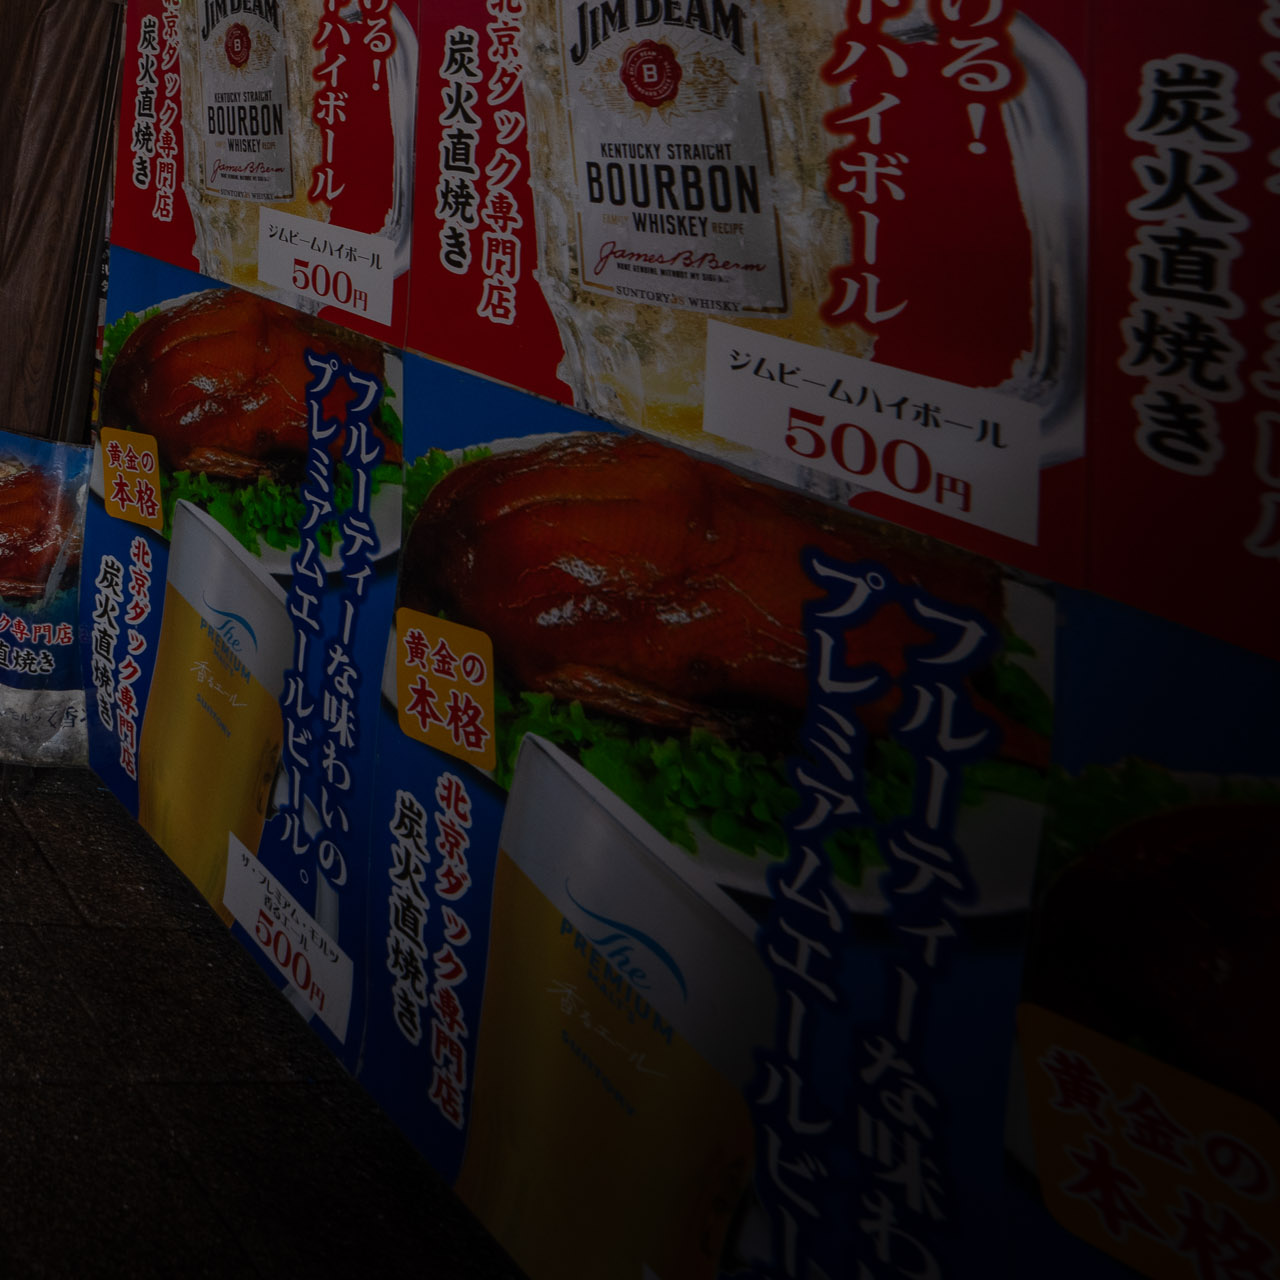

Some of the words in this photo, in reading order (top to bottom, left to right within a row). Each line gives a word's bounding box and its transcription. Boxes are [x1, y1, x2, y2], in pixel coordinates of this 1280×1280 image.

[131, 14, 160, 190] 炭火直焼き
[214, 91, 241, 103] KENTUCKY
[243, 89, 273, 102] STRAIGHT
[641, 63, 659, 83] B
[207, 103, 284, 136] BOURBON
[228, 138, 261, 153] WHISKEY
[439, 26, 482, 275] 炭火直焼き
[600, 142, 661, 160] KENTUCKY
[667, 142, 732, 161] STRAIGHT
[586, 161, 761, 214] BOURBON
[267, 221, 383, 272] ジムビームハイボール
[632, 212, 708, 237] WHISKEY
[711, 222, 745, 235] RECIPE
[290, 255, 369, 313] 500円
[1120, 55, 1250, 477] 炭火直焼き
[688, 297, 741, 312] WHISKY
[728, 347, 1007, 450] ジムビームハイボール
[107, 440, 155, 473] 黄金の
[784, 407, 972, 513] 500円
[110, 475, 160, 518] 本格
[92, 555, 125, 731] 炭火直焼き
[117, 537, 153, 782] 北京ダック専門店
[200, 621, 252, 686] PREMIUM
[319, 371, 381, 887] フルーティーな味わいの
[404, 628, 485, 686] 黄金の
[405, 680, 490, 752] 本格
[387, 788, 430, 1048] 炭火直焼き
[427, 771, 472, 1131] 北京ダック専門店
[750, 557, 886, 1280] プレミアムエールビー
[255, 907, 326, 1015] 500円
[559, 917, 676, 1046] PREMIUM
[1036, 1043, 1276, 1204] 黄金の
